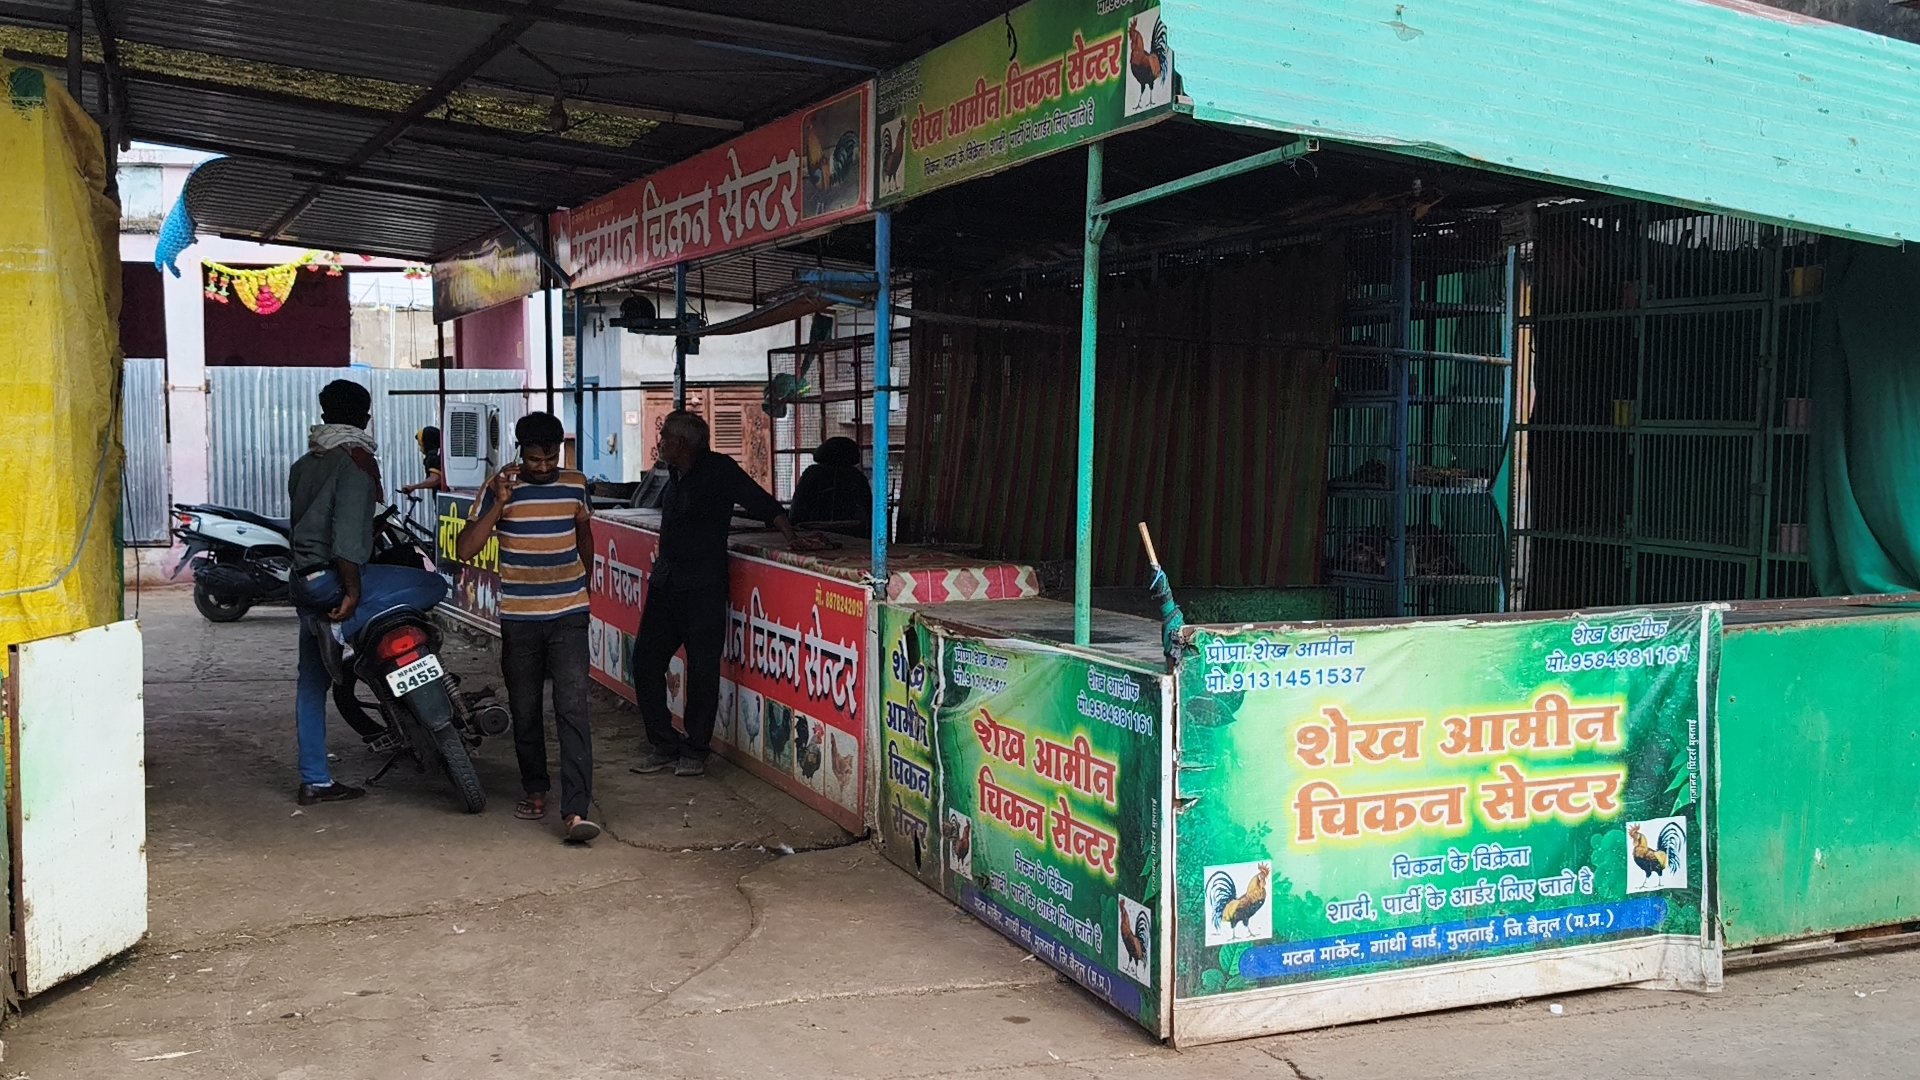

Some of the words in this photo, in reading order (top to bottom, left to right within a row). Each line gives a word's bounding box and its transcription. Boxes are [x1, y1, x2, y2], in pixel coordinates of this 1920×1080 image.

[912, 103, 944, 150] शेख
[948, 77, 1002, 137] आमीन
[1005, 61, 1064, 117] चिकन
[1067, 34, 1123, 91] सेन्टर
[1053, 108, 1068, 134] लिए
[1069, 100, 1086, 127] जाते
[641, 181, 712, 264] चिकन
[718, 148, 800, 244] सेन्टर
[608, 539, 643, 612] चिकन
[815, 582, 824, 606] मो.
[750, 587, 801, 690] चिकन
[805, 604, 859, 717] सेन्टर
[1295, 635, 1355, 657] आमीन
[1546, 645, 1690, 671] मो.9584381161
[1572, 622, 1604, 645] शेख
[1610, 617, 1669, 641] आशीफ
[396, 665, 439, 693] 9455
[1088, 665, 1106, 693] शेख
[1206, 667, 1366, 691] मो.9131451537
[1077, 689, 1153, 736] मो.9584381161
[1296, 708, 1424, 767] शेख
[1440, 694, 1620, 755] आमीन
[888, 740, 931, 799] चिकन
[973, 708, 1026, 768] शेख
[1033, 735, 1117, 803] आमीन
[978, 765, 1046, 841] चिकन
[1051, 796, 1117, 876] सेन्टर
[1294, 782, 1466, 841] चिकन
[1481, 765, 1621, 821] सेन्टर
[1014, 848, 1036, 881] चिकन
[1037, 859, 1046, 885] के
[1392, 853, 1444, 879] चिकन
[1448, 849, 1467, 871] के
[1473, 844, 1531, 870] विक्रेता
[1026, 885, 1036, 910] के
[1058, 904, 1074, 938] लिए
[1075, 918, 1093, 947] जाते
[1327, 893, 1377, 923] शादी,
[1383, 887, 1422, 915] पार्टी
[1427, 885, 1446, 908] के
[1451, 878, 1494, 907] आर्डर
[1499, 875, 1533, 903] लिए
[1539, 868, 1575, 895] जाते
[1578, 865, 1593, 893] है
[1282, 949, 1315, 966] मटन
[1320, 939, 1365, 960] मार्केट,
[1370, 932, 1407, 953] गांधी
[1411, 927, 1442, 949] वार्ड,
[1446, 920, 1499, 950] मुलताई,
[1503, 916, 1561, 938] जि.बैतूल
[1566, 909, 1614, 932] (म.प्र.)
